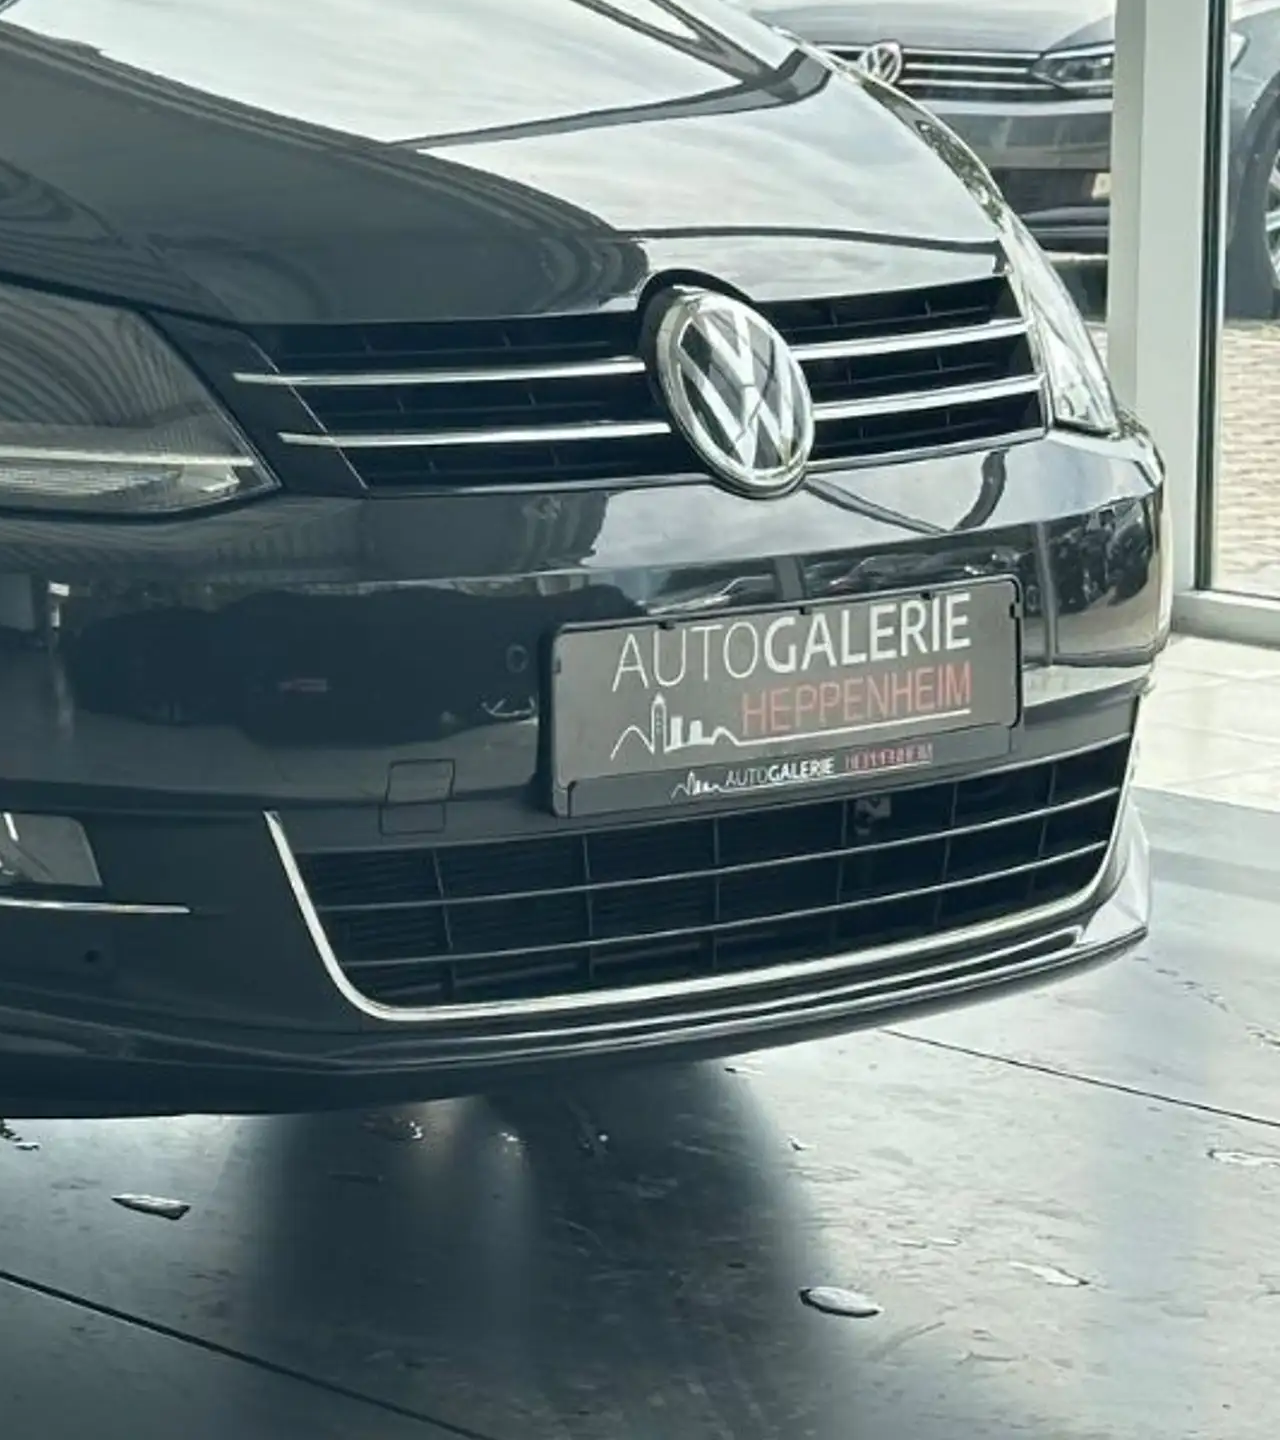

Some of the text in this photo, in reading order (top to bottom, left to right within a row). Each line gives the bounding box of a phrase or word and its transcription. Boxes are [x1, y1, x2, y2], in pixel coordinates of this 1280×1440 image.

[662, 295, 810, 482] VW
[611, 593, 972, 692] AUTOGALERIE
[742, 661, 971, 735] HEPPENHEIM
[726, 757, 834, 788] AUTOGALERIE
